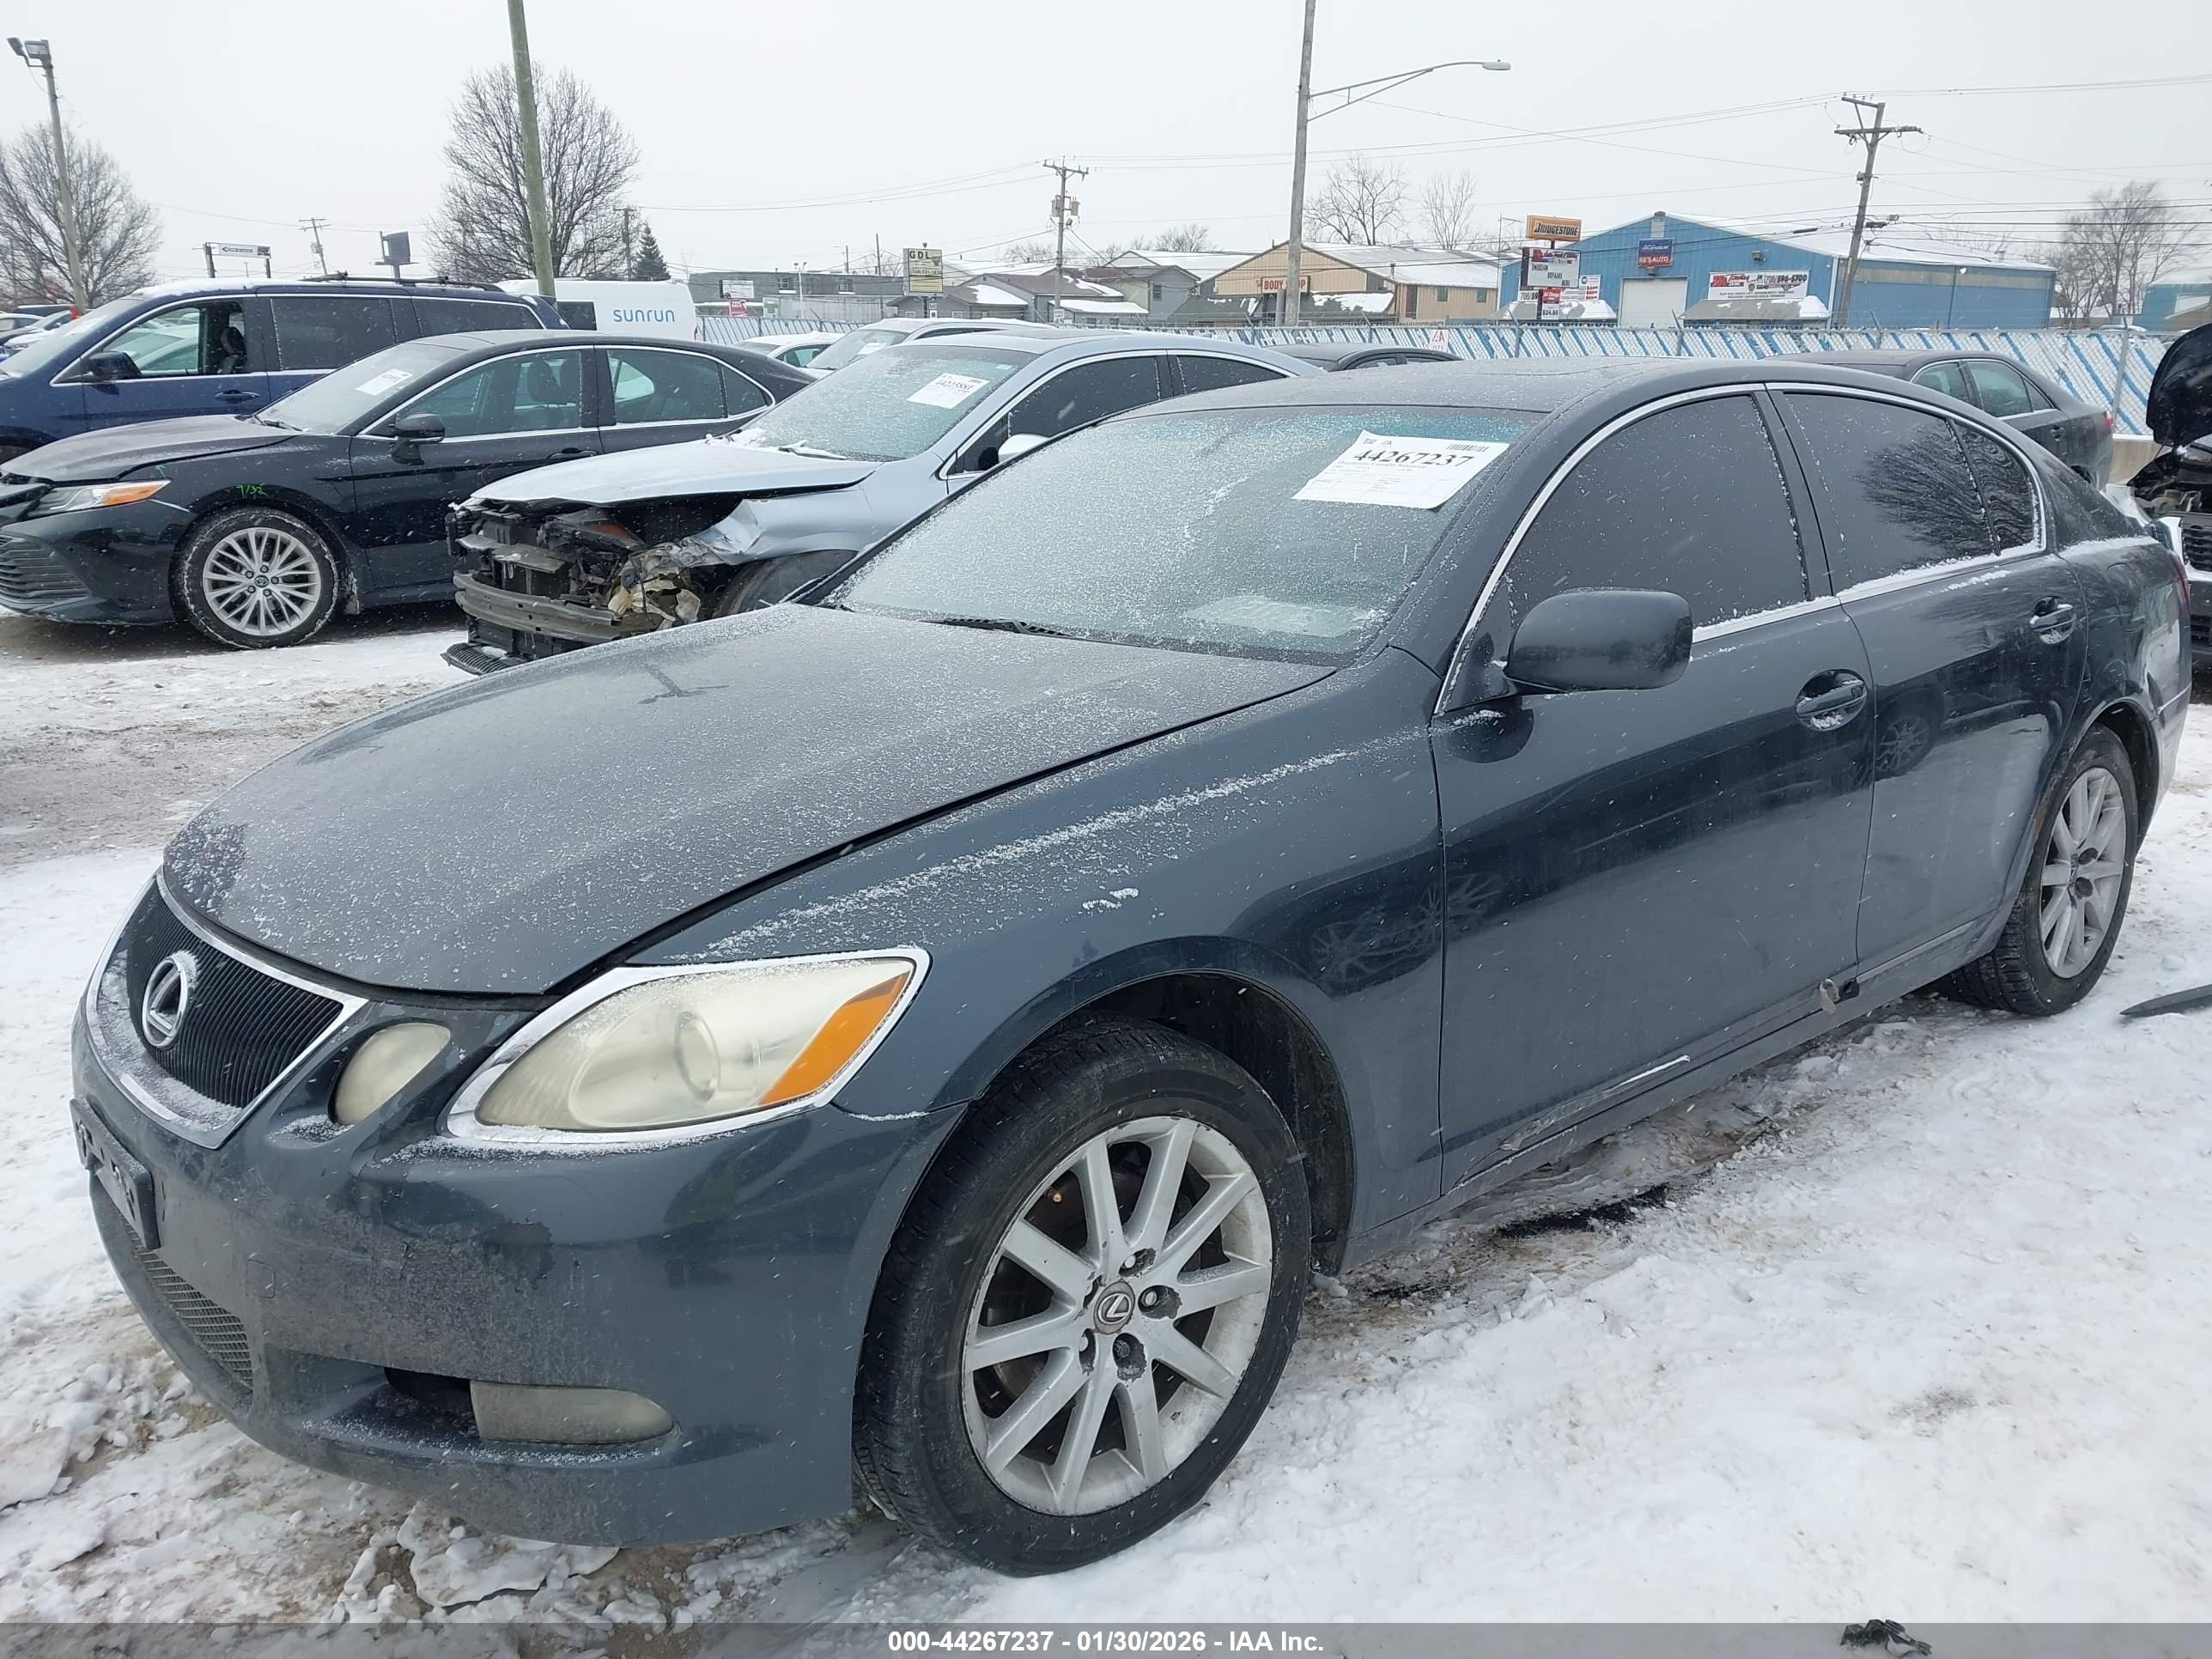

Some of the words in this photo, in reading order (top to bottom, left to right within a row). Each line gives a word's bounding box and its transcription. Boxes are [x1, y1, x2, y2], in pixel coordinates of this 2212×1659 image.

[1534, 222, 1578, 236] BRIDGESTONE
[909, 251, 932, 259] GDL
[1264, 280, 1284, 290] BODY
[613, 309, 675, 322] sunrun
[1353, 449, 1475, 467] 44267237
